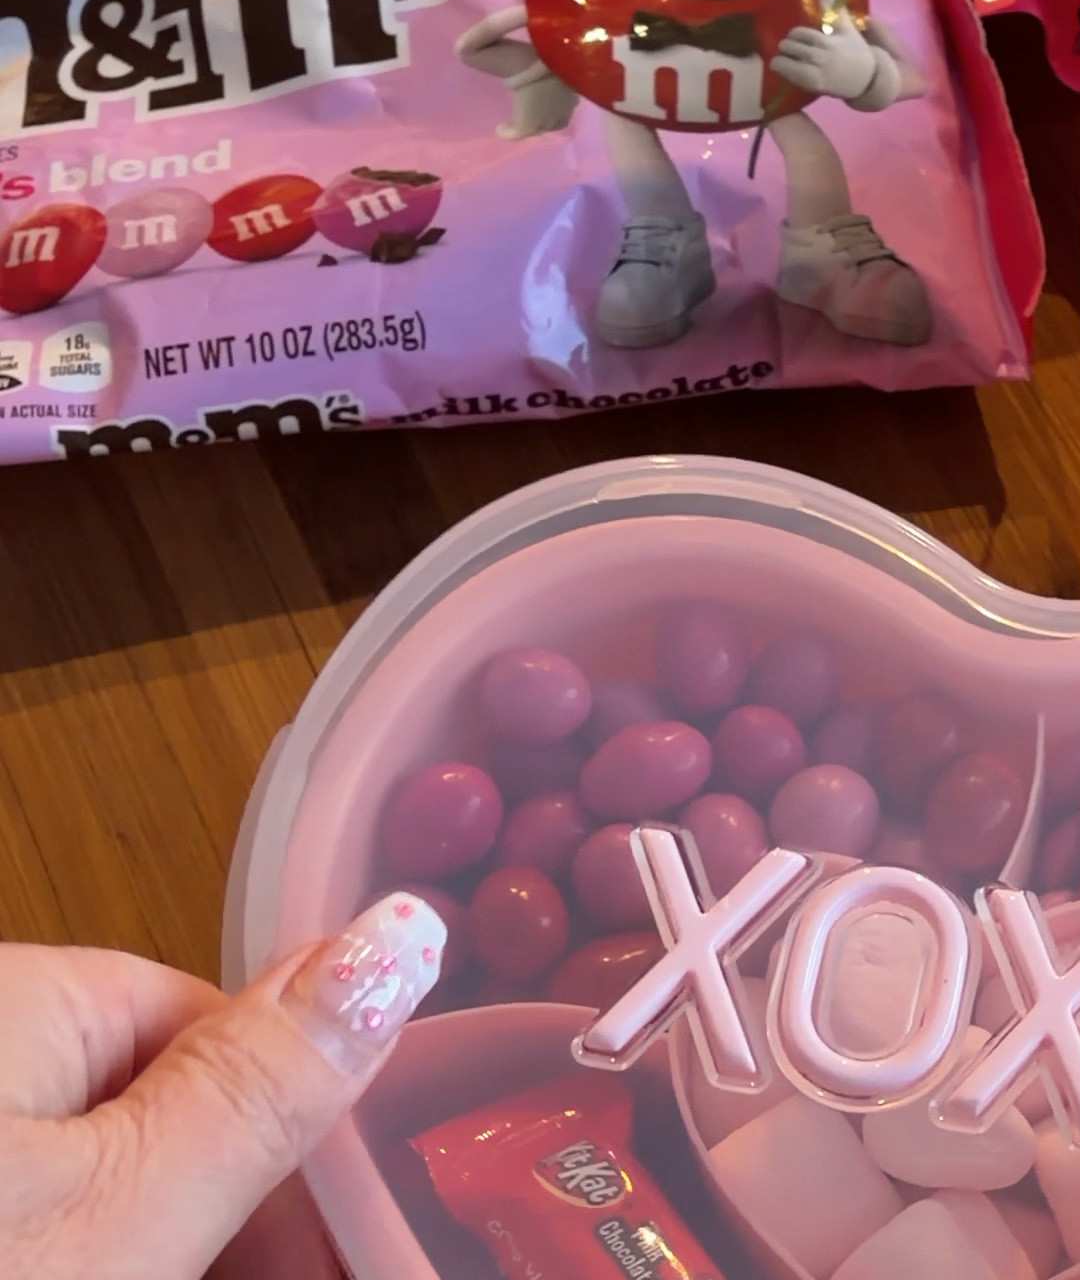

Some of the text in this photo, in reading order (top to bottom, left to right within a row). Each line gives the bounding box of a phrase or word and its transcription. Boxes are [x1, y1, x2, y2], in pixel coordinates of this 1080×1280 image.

[612, 35, 767, 123] m
[48, 139, 232, 193] blend
[4, 187, 408, 268] m m m m
[50, 362, 101, 377] SUGARS
[144, 311, 427, 379] NET WT 10 OZ (283.5g)
[10, 405, 62, 418] ACTUAL
[67, 404, 97, 418] SIZE
[526, 360, 775, 410] chocolate
